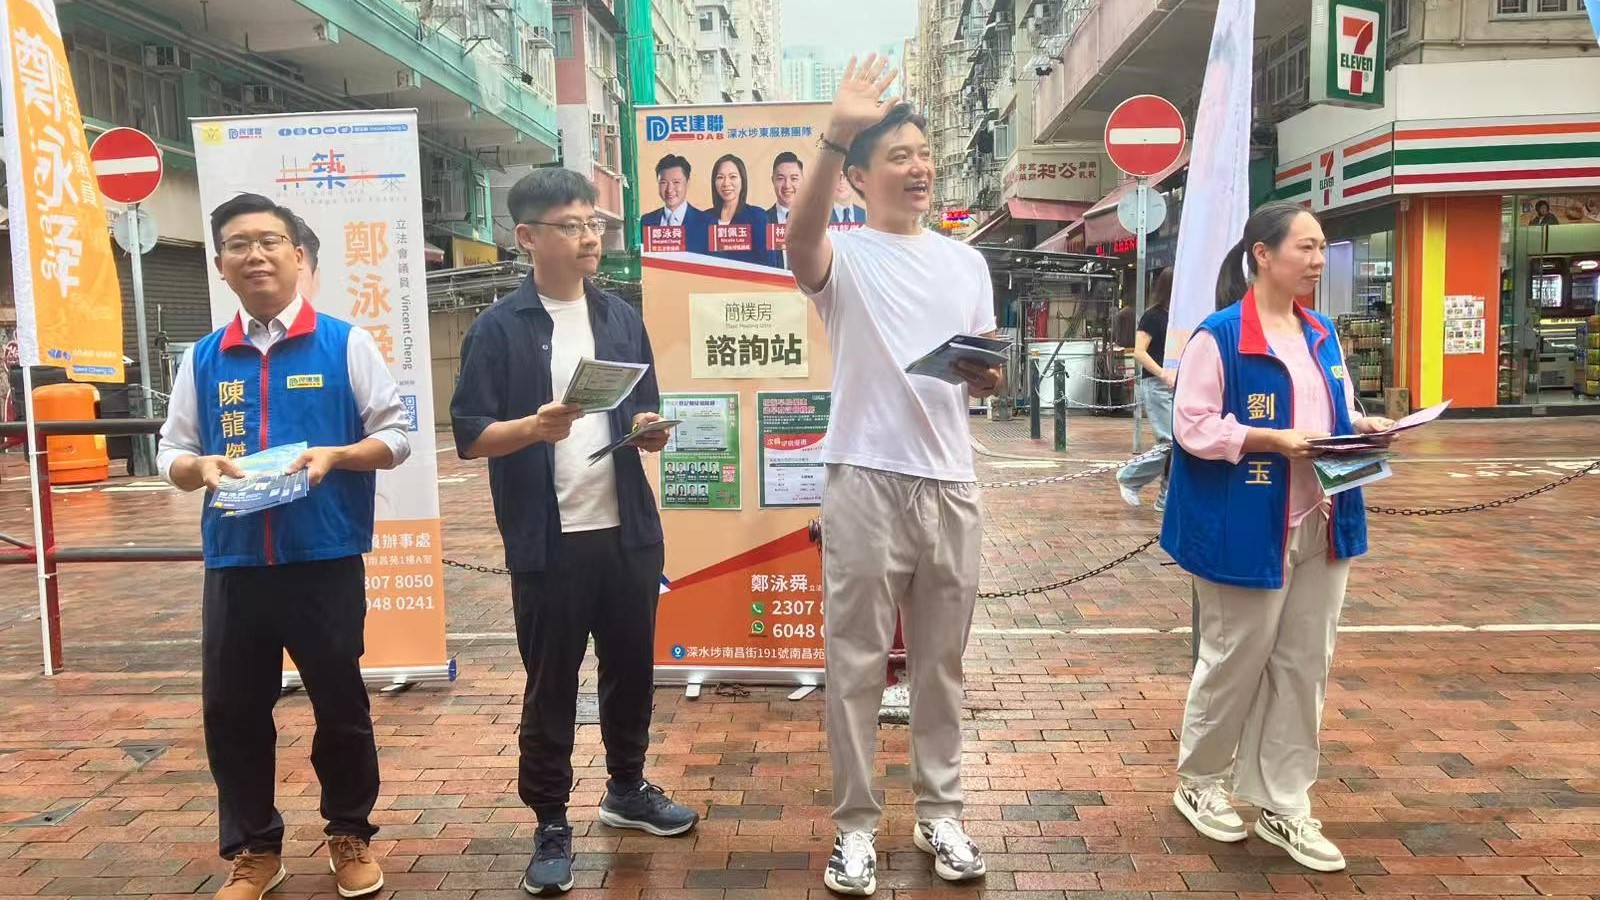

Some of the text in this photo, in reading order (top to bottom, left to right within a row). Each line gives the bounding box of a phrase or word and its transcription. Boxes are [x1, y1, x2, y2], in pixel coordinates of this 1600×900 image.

[671, 115, 724, 133] 民建聯
[697, 133, 724, 141] DAB
[652, 228, 682, 238] 鄭泳舜
[718, 227, 747, 238] 劉佩玉
[400, 295, 413, 333] Vincent
[725, 302, 772, 322] 簡樸房
[402, 336, 413, 370] Cheng
[706, 333, 802, 367] 諮詢站
[395, 575, 433, 588] 8050
[751, 574, 808, 593] 鄭泳舜
[396, 596, 433, 609] 0241
[772, 600, 814, 615] 2307
[773, 623, 815, 638] 6048
[687, 646, 824, 660] 深水埗南昌街191號南昌苑
